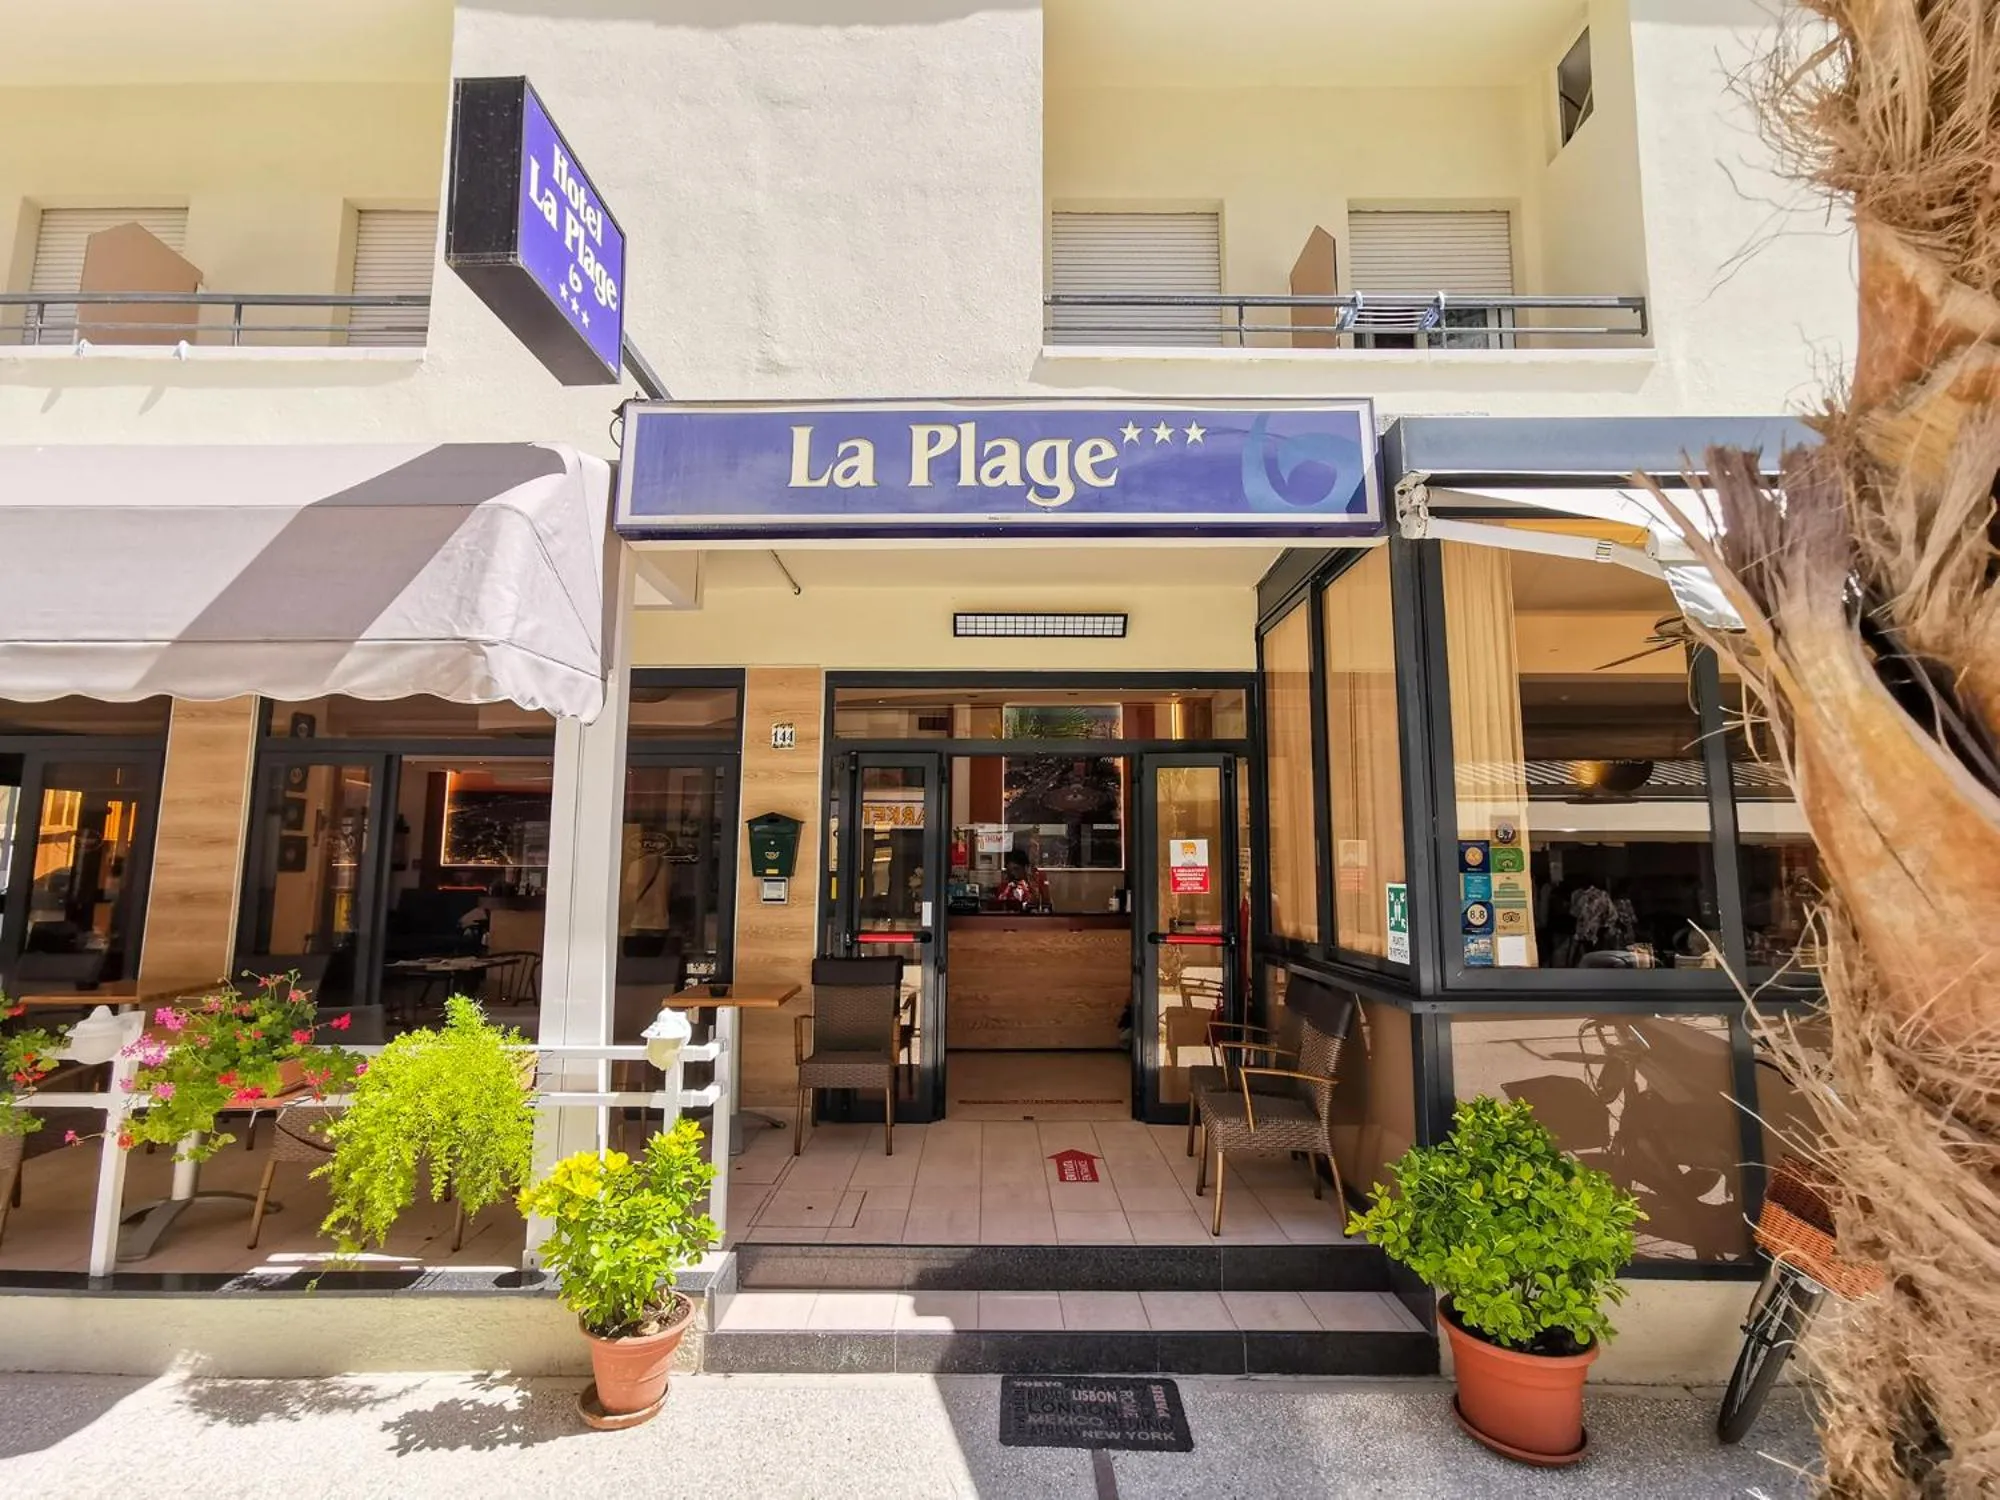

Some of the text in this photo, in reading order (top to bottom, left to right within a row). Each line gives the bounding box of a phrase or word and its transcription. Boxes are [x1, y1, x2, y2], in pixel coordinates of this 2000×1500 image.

[553, 144, 602, 247] Hotel
[529, 155, 617, 312] La Plage
[788, 421, 1119, 508] La Plage
[774, 730, 793, 742] 144
[1072, 1390, 1117, 1403] LISBON
[1028, 1401, 1118, 1416] LONDON
[1027, 1414, 1104, 1428] MEXICO
[1082, 1430, 1176, 1441] NEW YORK
